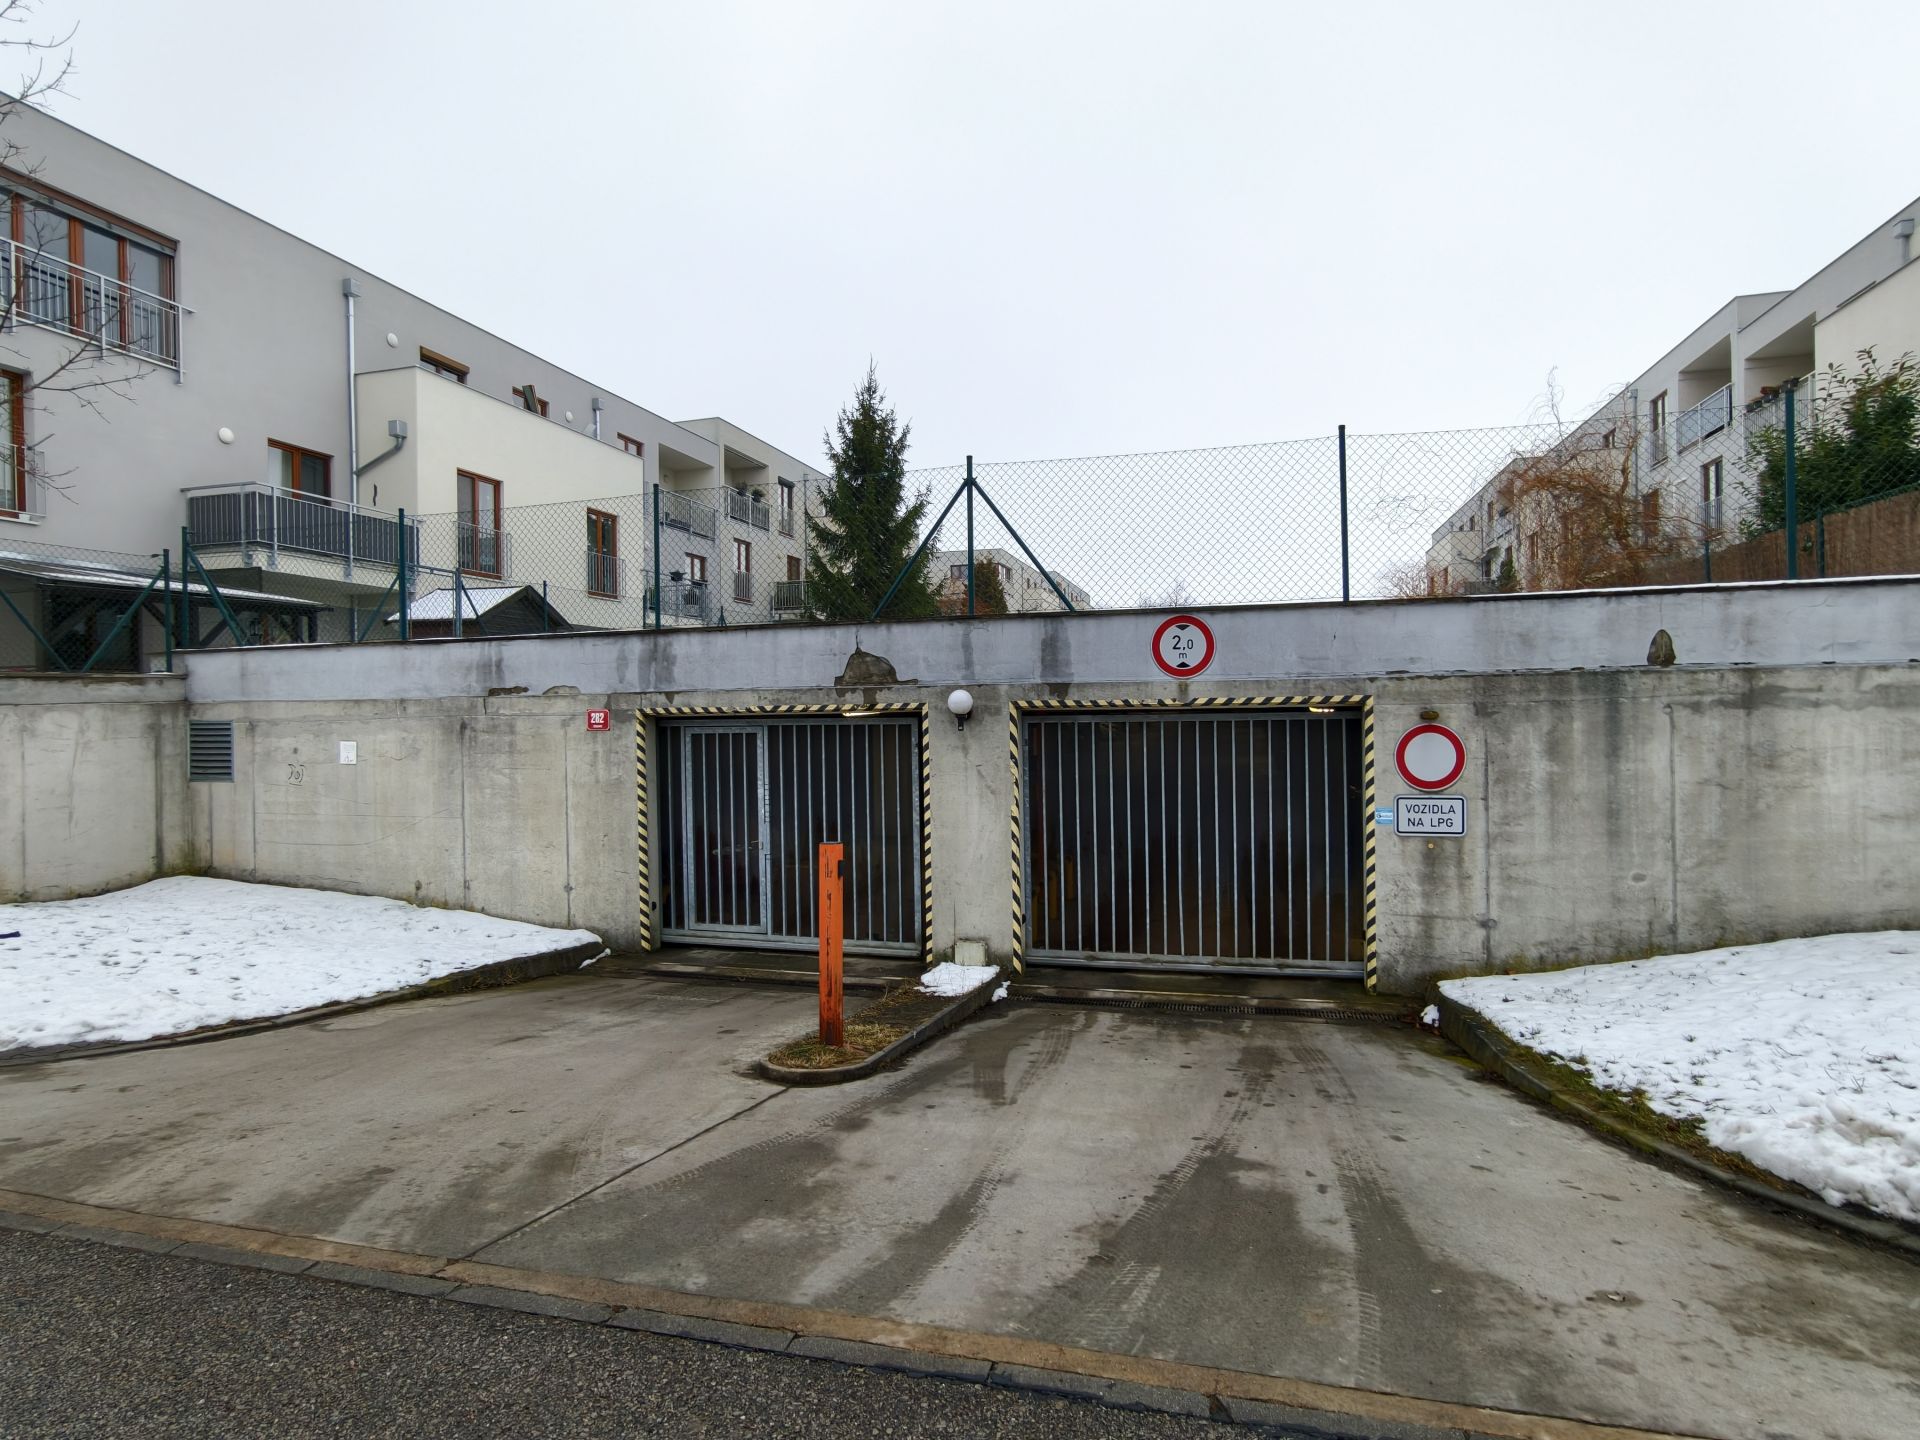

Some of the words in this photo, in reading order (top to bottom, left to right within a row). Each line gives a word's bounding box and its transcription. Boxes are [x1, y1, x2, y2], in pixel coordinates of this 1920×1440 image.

[1172, 635, 1194, 651] 2,0
[591, 713, 605, 723] 282
[1405, 804, 1456, 814] VOZIDLA
[1407, 817, 1425, 827] NA
[1430, 817, 1454, 827] LPG
